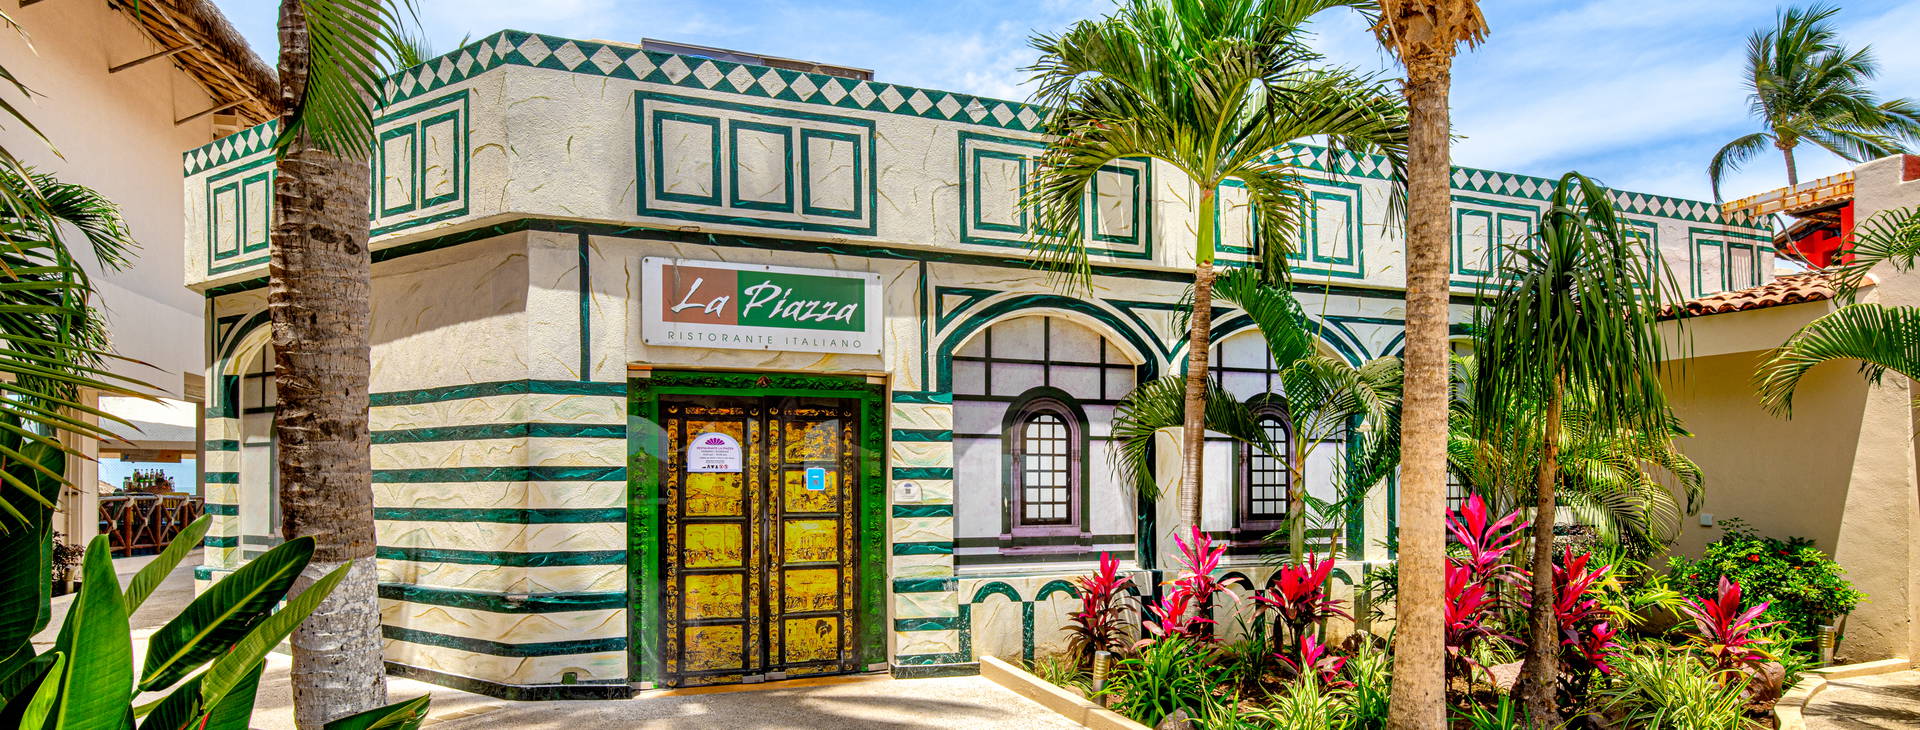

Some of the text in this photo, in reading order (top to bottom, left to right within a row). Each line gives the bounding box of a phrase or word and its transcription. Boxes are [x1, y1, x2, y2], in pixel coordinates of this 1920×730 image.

[671, 277, 858, 324] La Piazza
[668, 331, 862, 349] RISTORANTE ITALIANO
